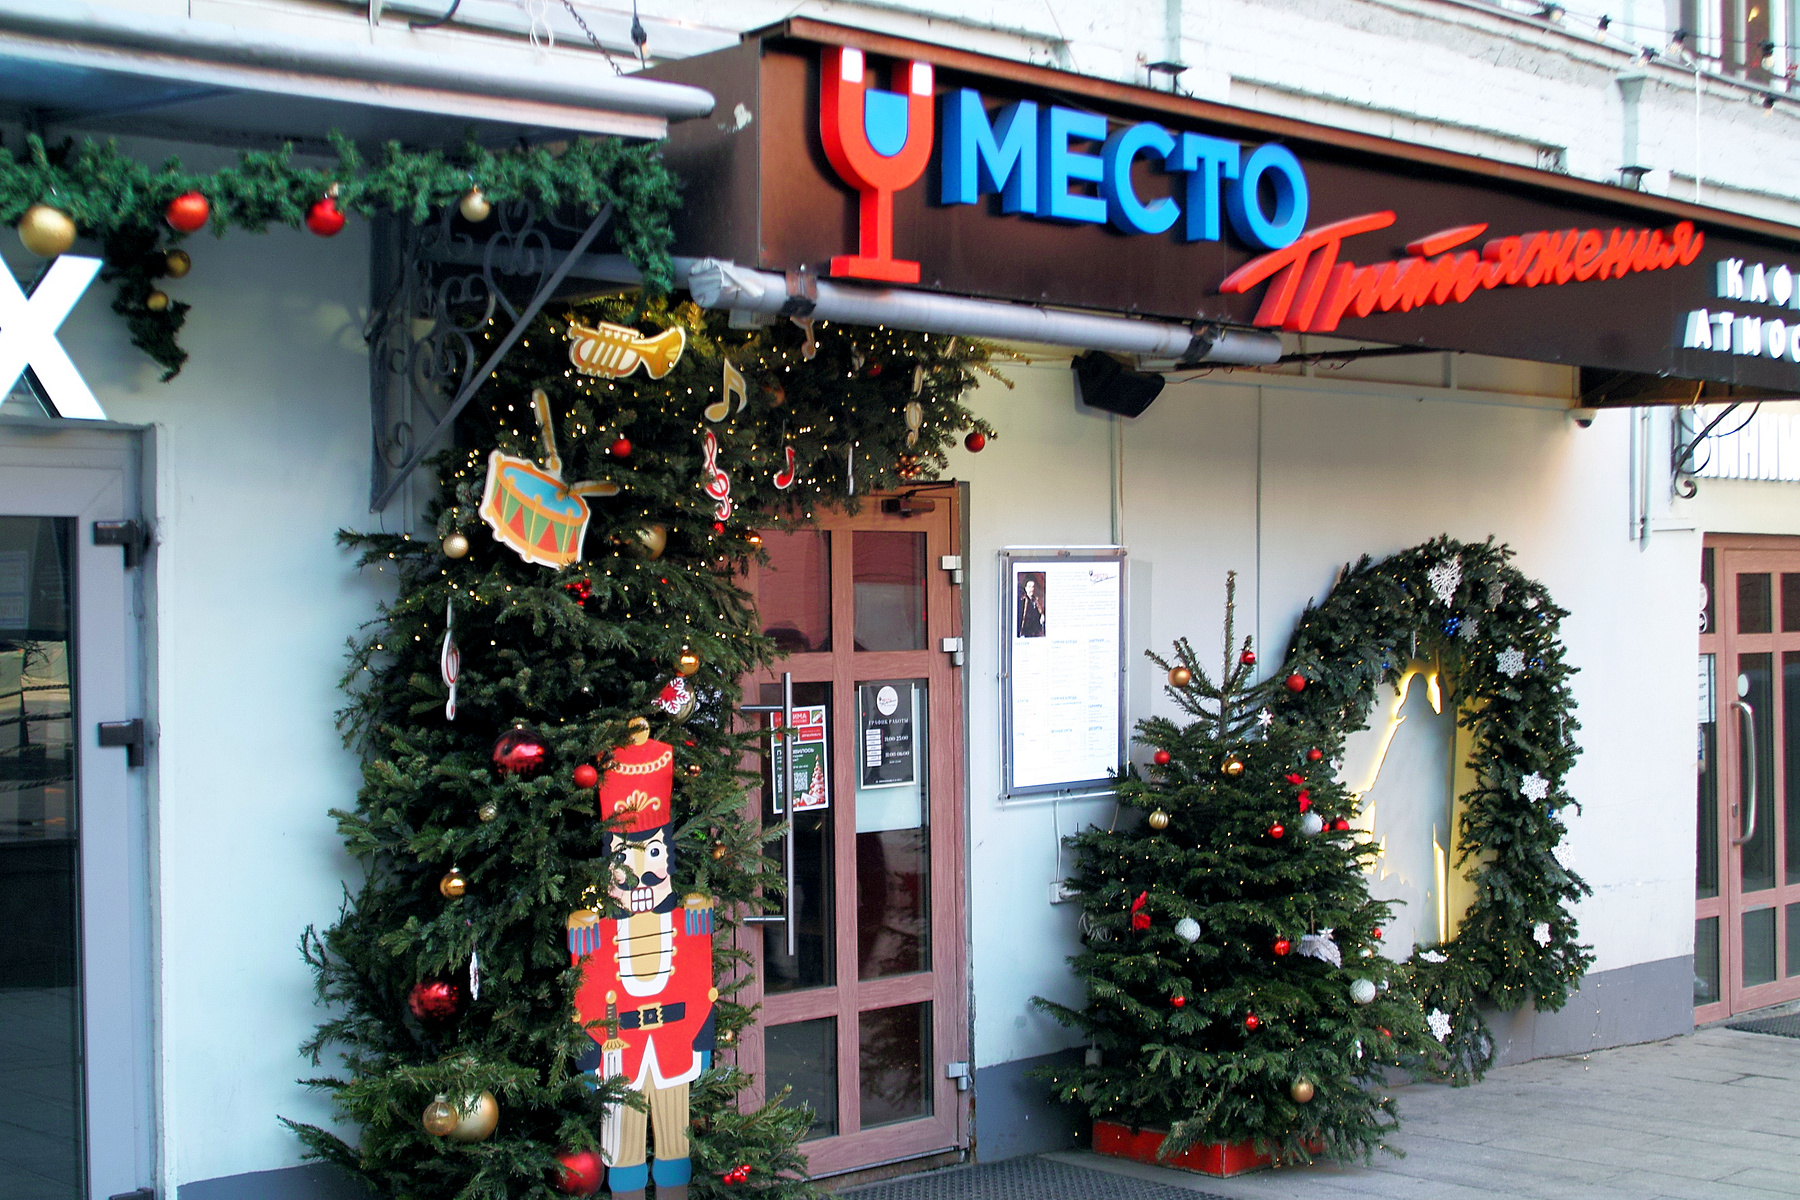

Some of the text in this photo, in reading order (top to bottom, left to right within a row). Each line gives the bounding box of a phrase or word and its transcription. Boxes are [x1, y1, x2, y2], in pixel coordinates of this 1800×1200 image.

[942, 87, 1310, 250] МЕСТО
[1219, 209, 1704, 332] Притяжения
[1716, 257, 1800, 311] КАФ
